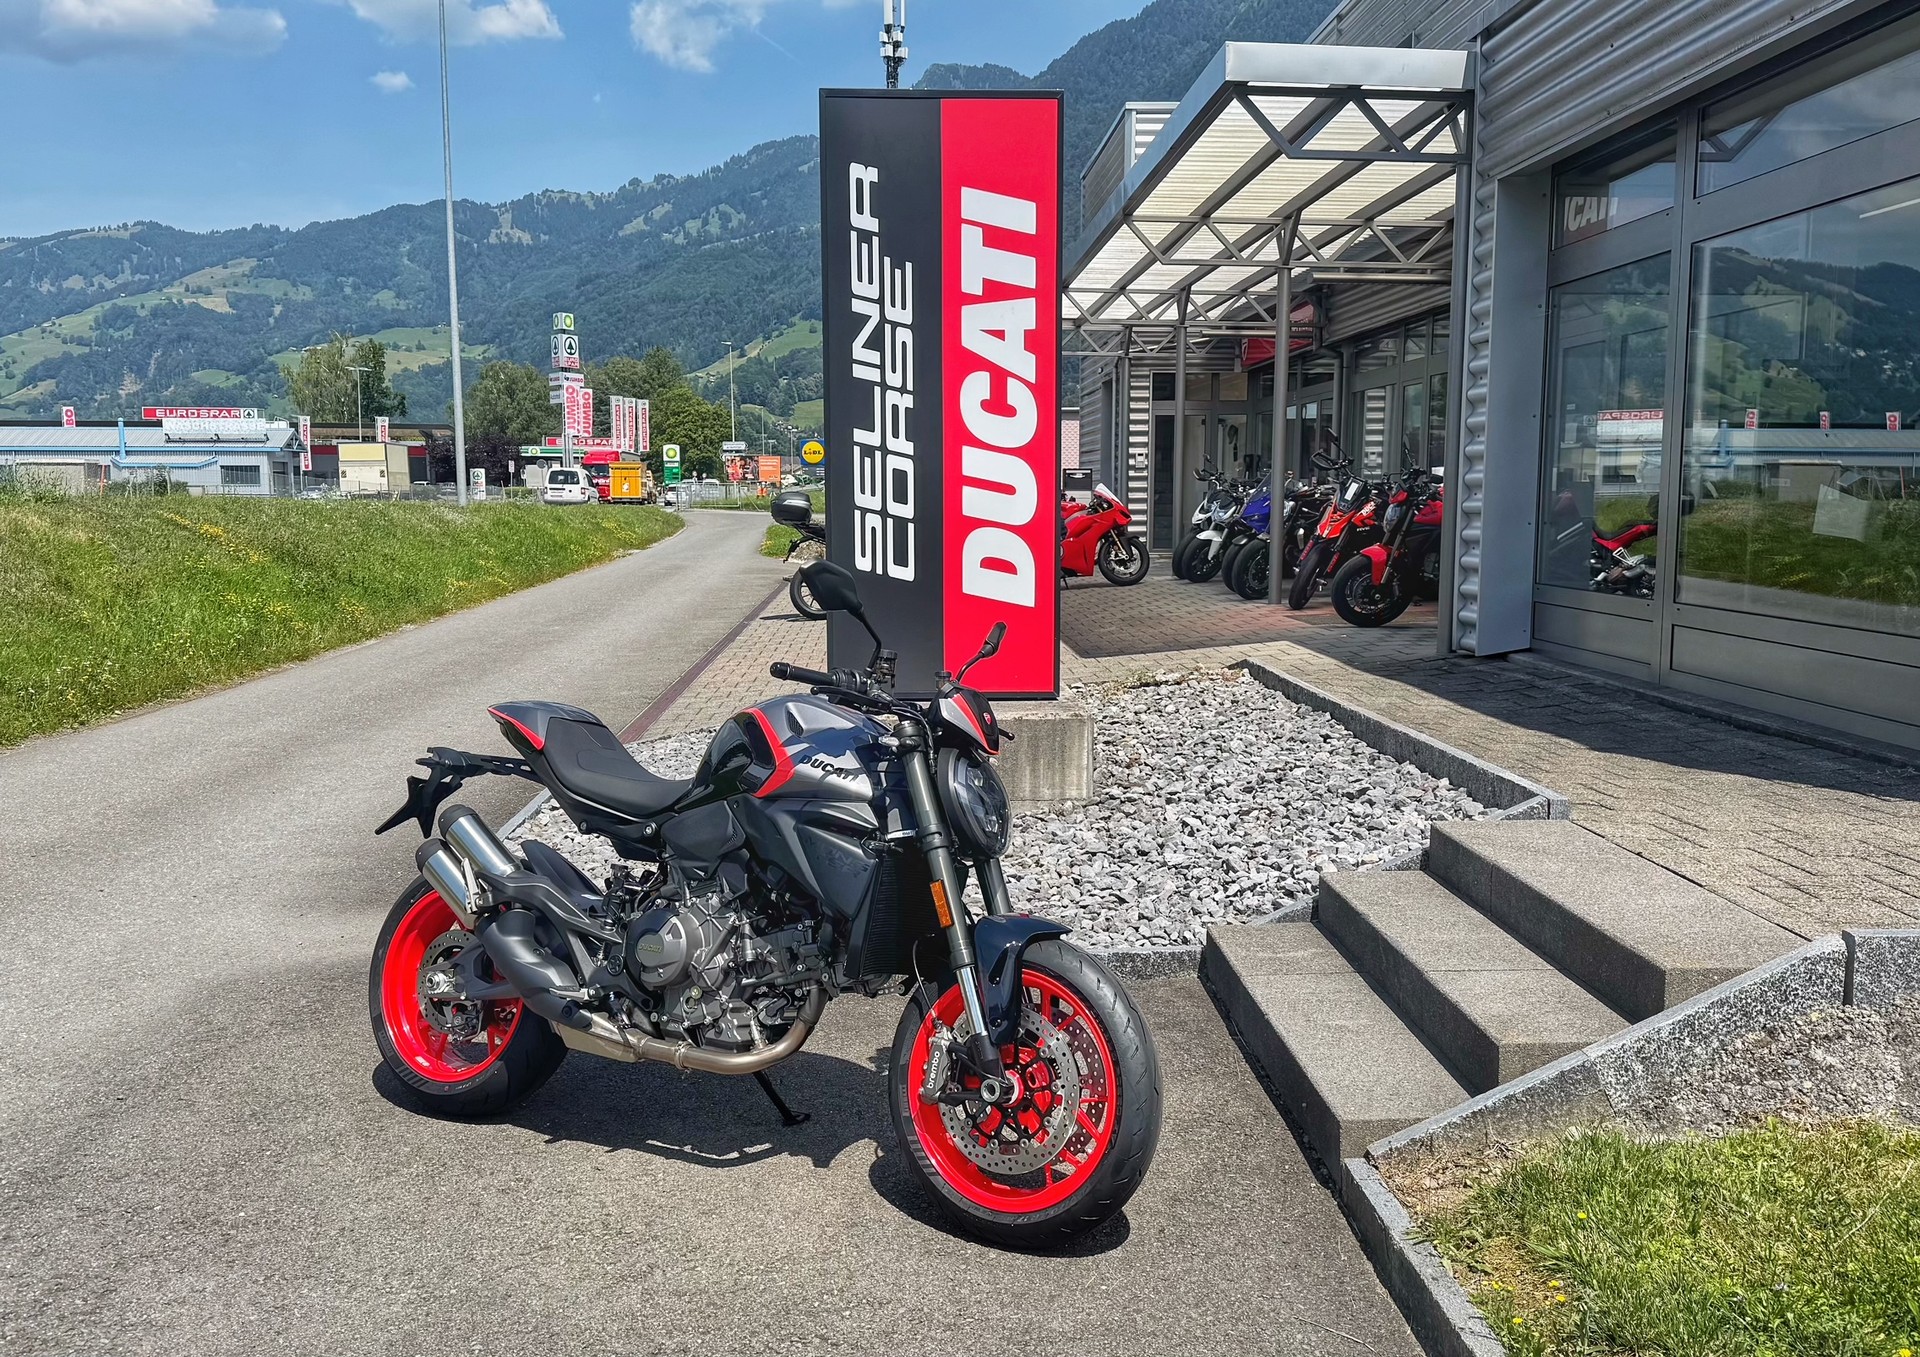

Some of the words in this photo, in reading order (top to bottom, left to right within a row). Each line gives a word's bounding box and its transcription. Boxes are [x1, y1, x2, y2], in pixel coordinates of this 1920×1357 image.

[849, 162, 883, 575] SELINER
[565, 384, 577, 431] JUMBO
[581, 391, 592, 435] JUMBO
[885, 255, 916, 582] CORSE
[960, 187, 1037, 607] DUCATI
[799, 755, 860, 782] DUCATI
[926, 1051, 940, 1089] brembo
